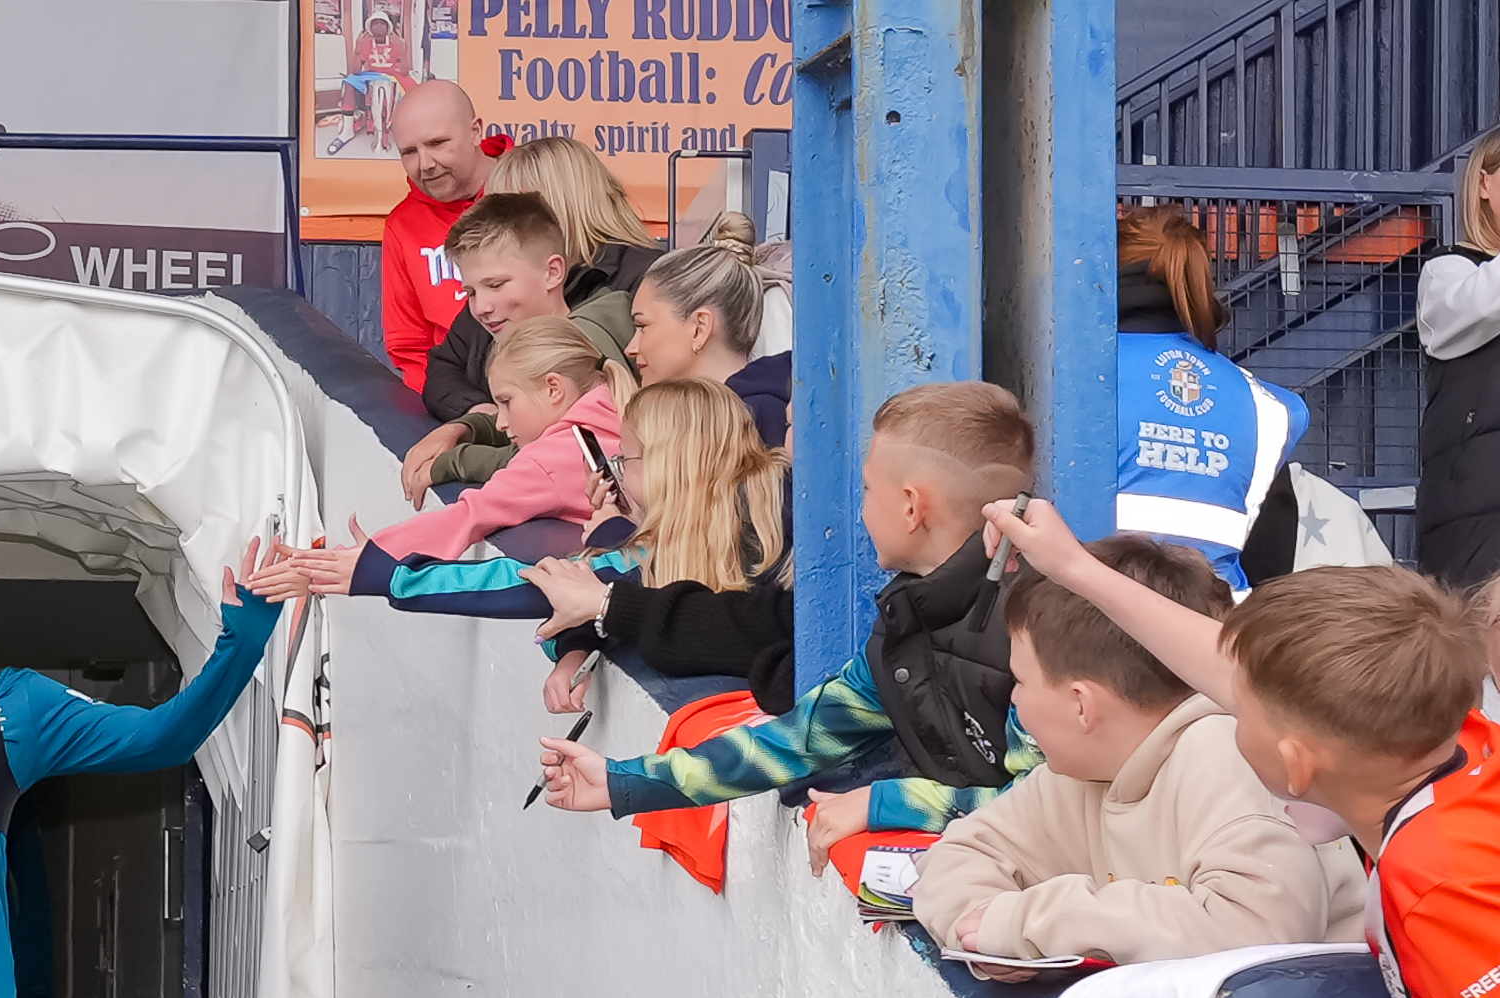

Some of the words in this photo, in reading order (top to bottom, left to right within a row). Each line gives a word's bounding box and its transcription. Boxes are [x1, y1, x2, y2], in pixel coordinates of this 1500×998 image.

[498, 49, 717, 104] Football:
[485, 119, 576, 143] oyalty
[594, 120, 670, 156] spirit
[681, 123, 736, 152] and
[1138, 421, 1196, 445] HERE
[1201, 430, 1230, 451] TO
[1135, 439, 1230, 478] HELP
